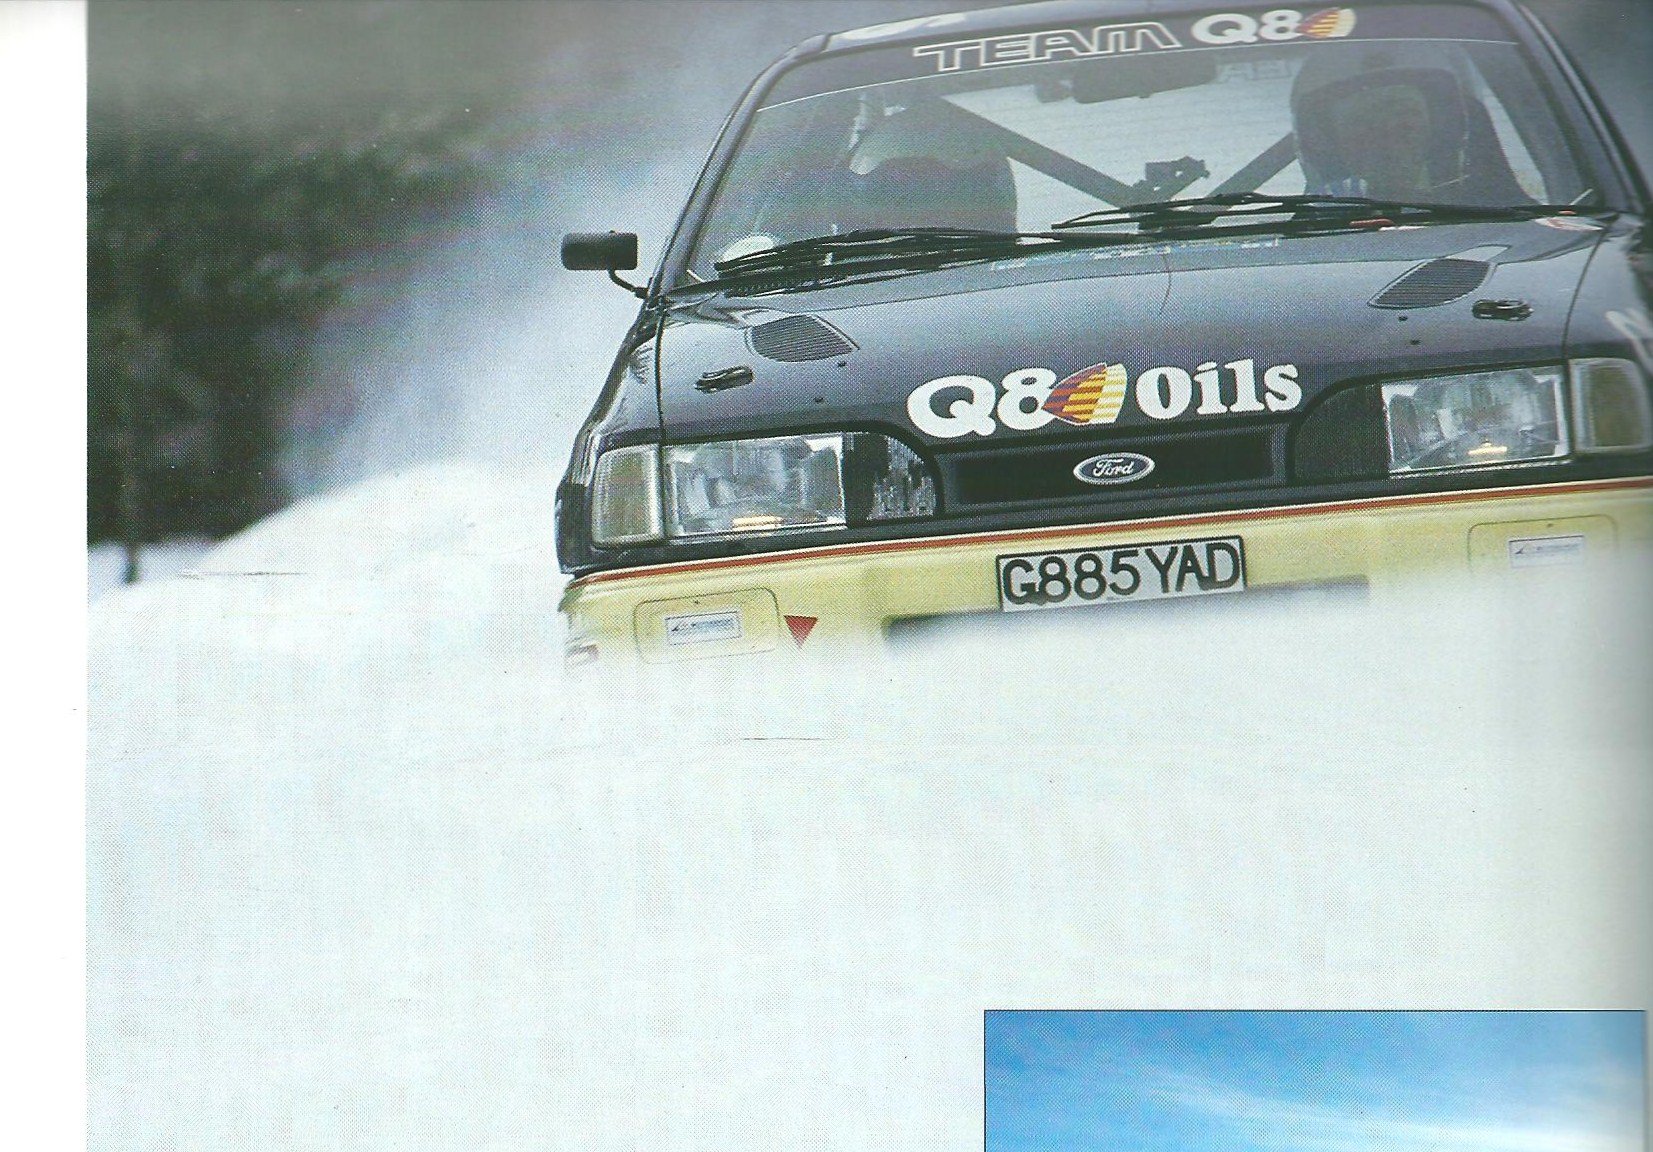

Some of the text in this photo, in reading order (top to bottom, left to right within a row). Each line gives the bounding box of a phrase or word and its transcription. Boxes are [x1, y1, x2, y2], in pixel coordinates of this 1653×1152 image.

[913, 22, 1183, 72] TEAM
[1192, 9, 1303, 45] Q8
[907, 358, 1303, 439] Q8 Oils
[1092, 458, 1135, 477] Ford
[1002, 541, 1242, 606] G885YAD
